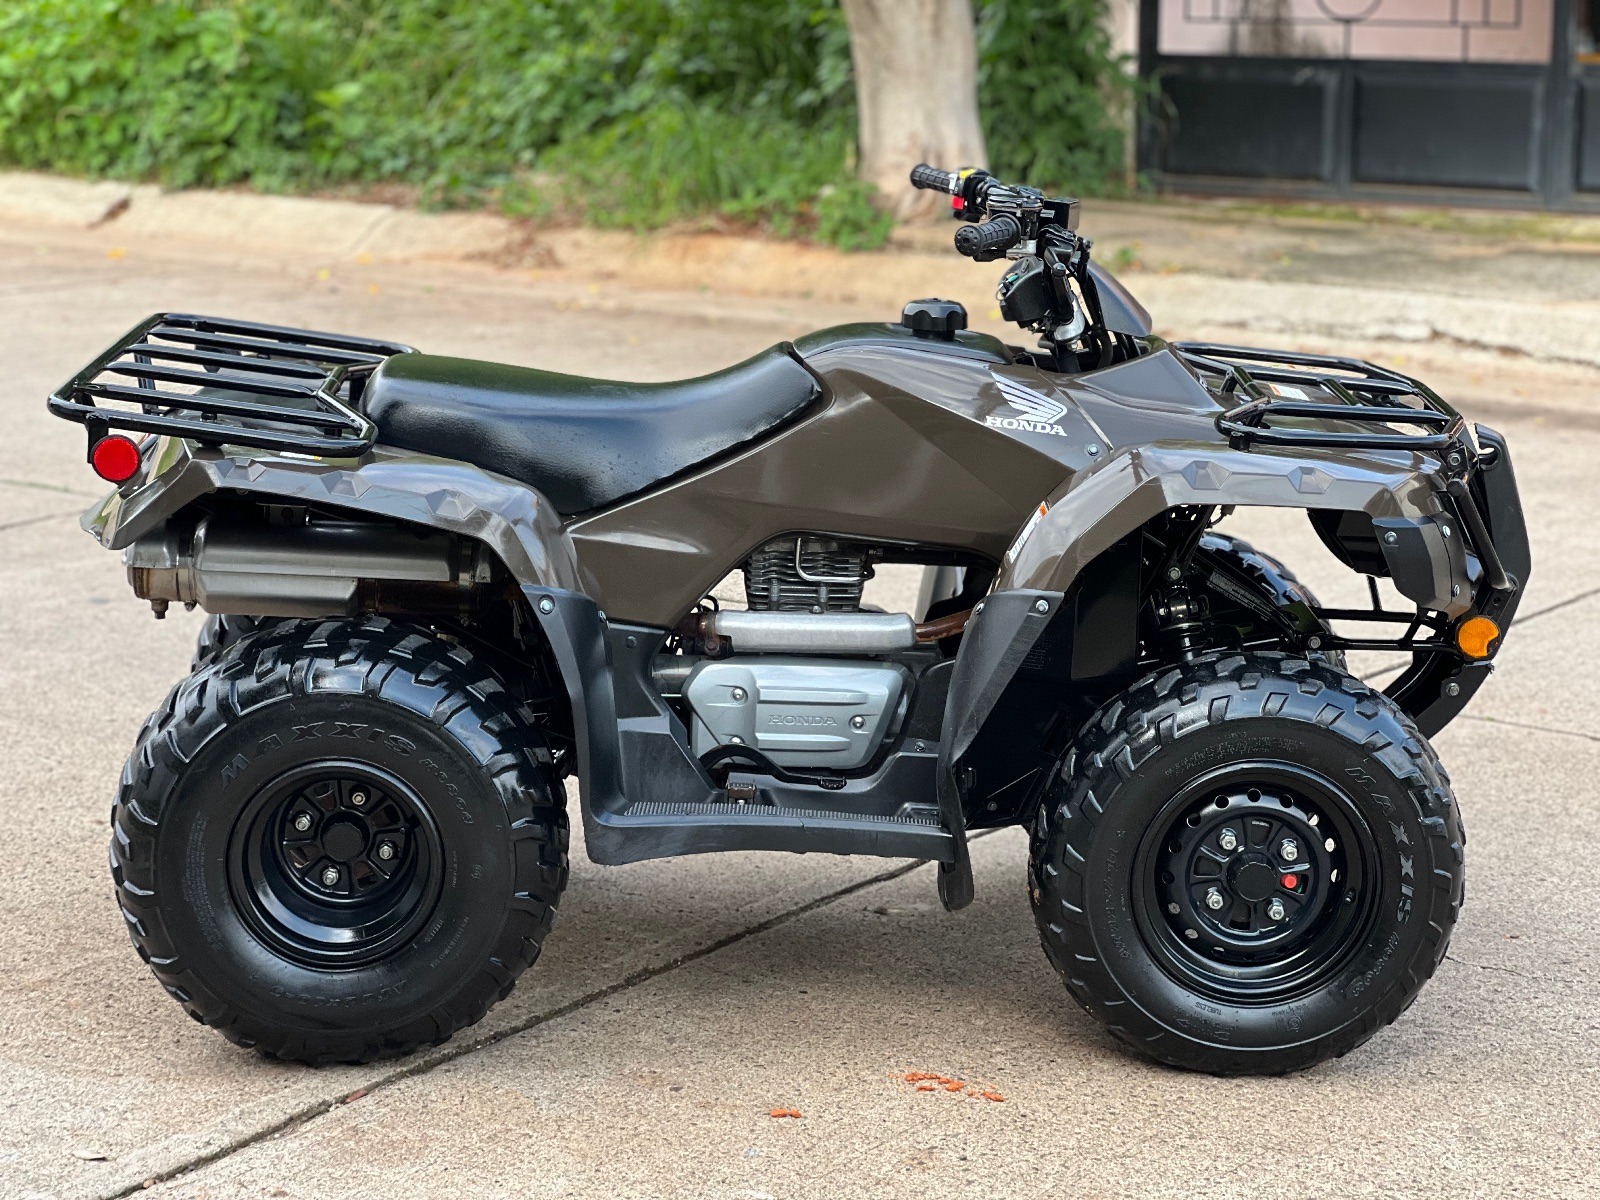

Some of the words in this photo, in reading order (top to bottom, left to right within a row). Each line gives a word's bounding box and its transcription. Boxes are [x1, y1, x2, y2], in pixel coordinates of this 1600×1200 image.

[984, 415, 1067, 437] HONDA
[767, 713, 838, 727] HONDA
[221, 721, 417, 791] MAXXIS
[1344, 766, 1415, 925] MAXXIS
[1194, 1001, 1222, 1016] TUBELESS
